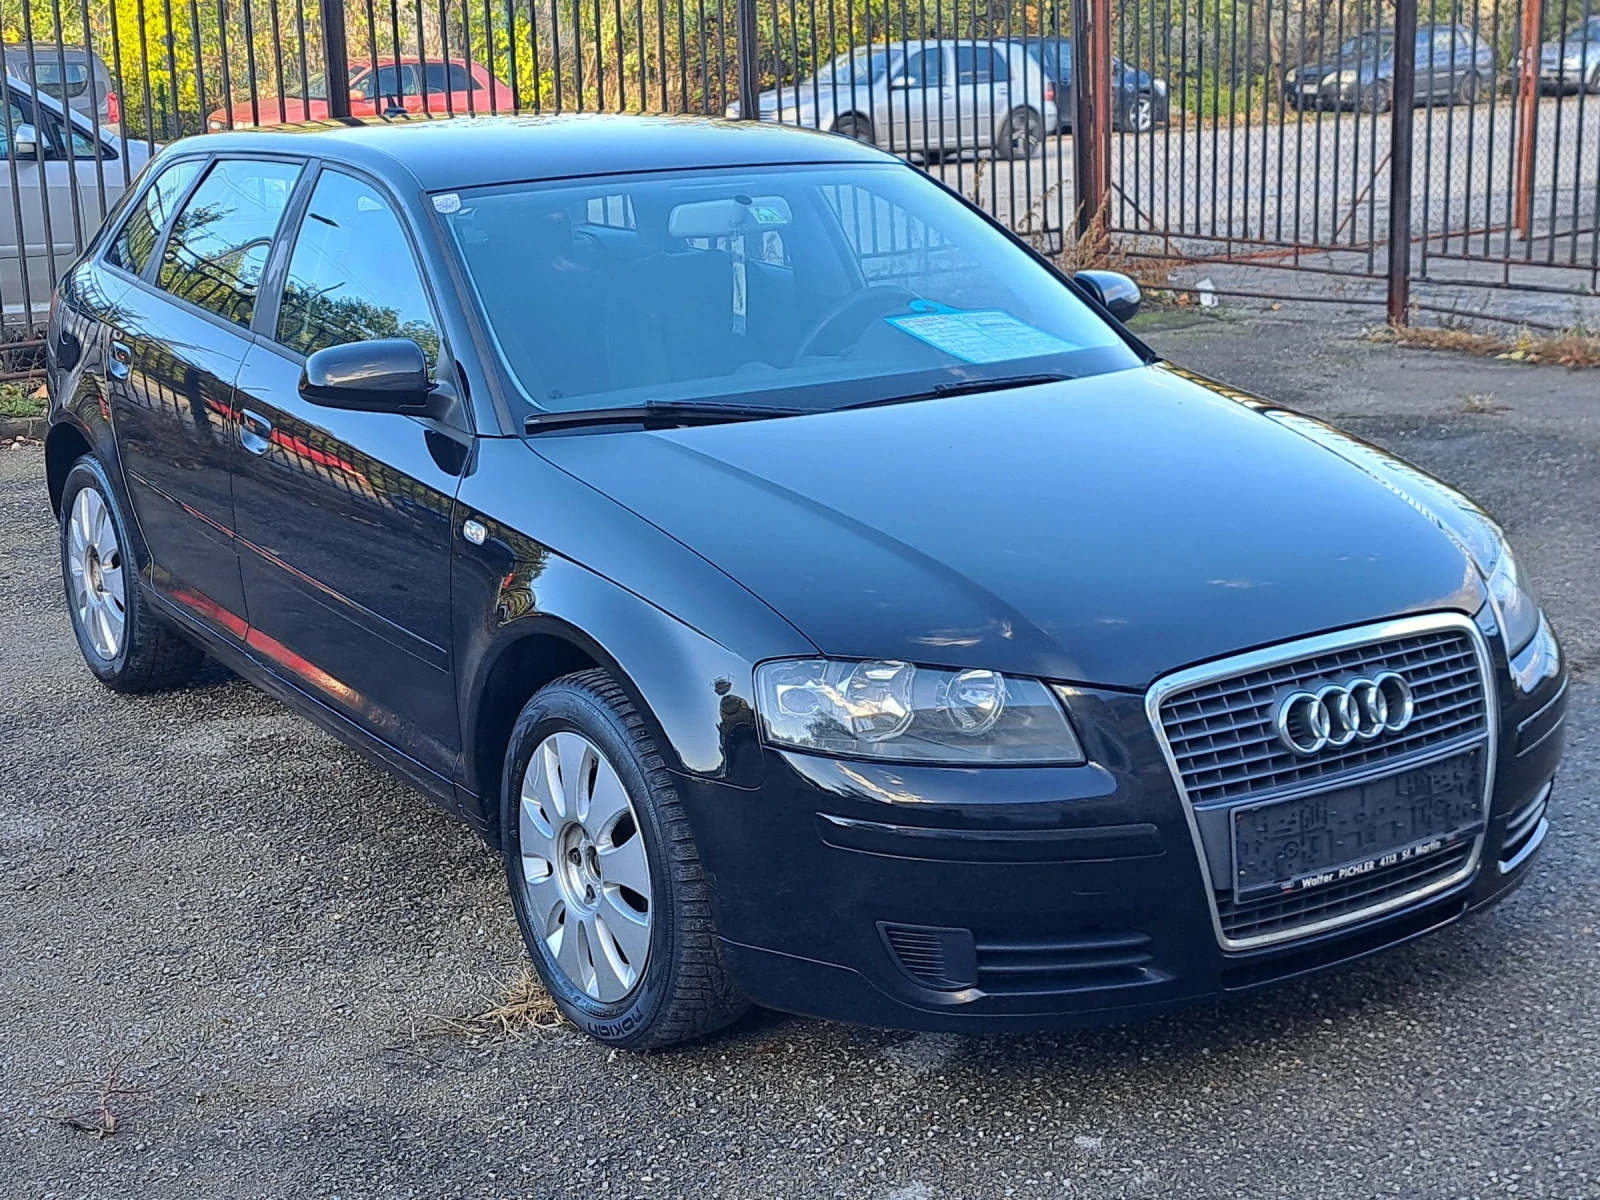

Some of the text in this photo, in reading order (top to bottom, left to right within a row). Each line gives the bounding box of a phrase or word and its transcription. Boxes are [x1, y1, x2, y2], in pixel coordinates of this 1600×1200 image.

[1302, 872, 1334, 889] Walter
[1338, 860, 1375, 879] PICHLER
[1379, 853, 1398, 867] 4113
[1415, 840, 1441, 856] Martin
